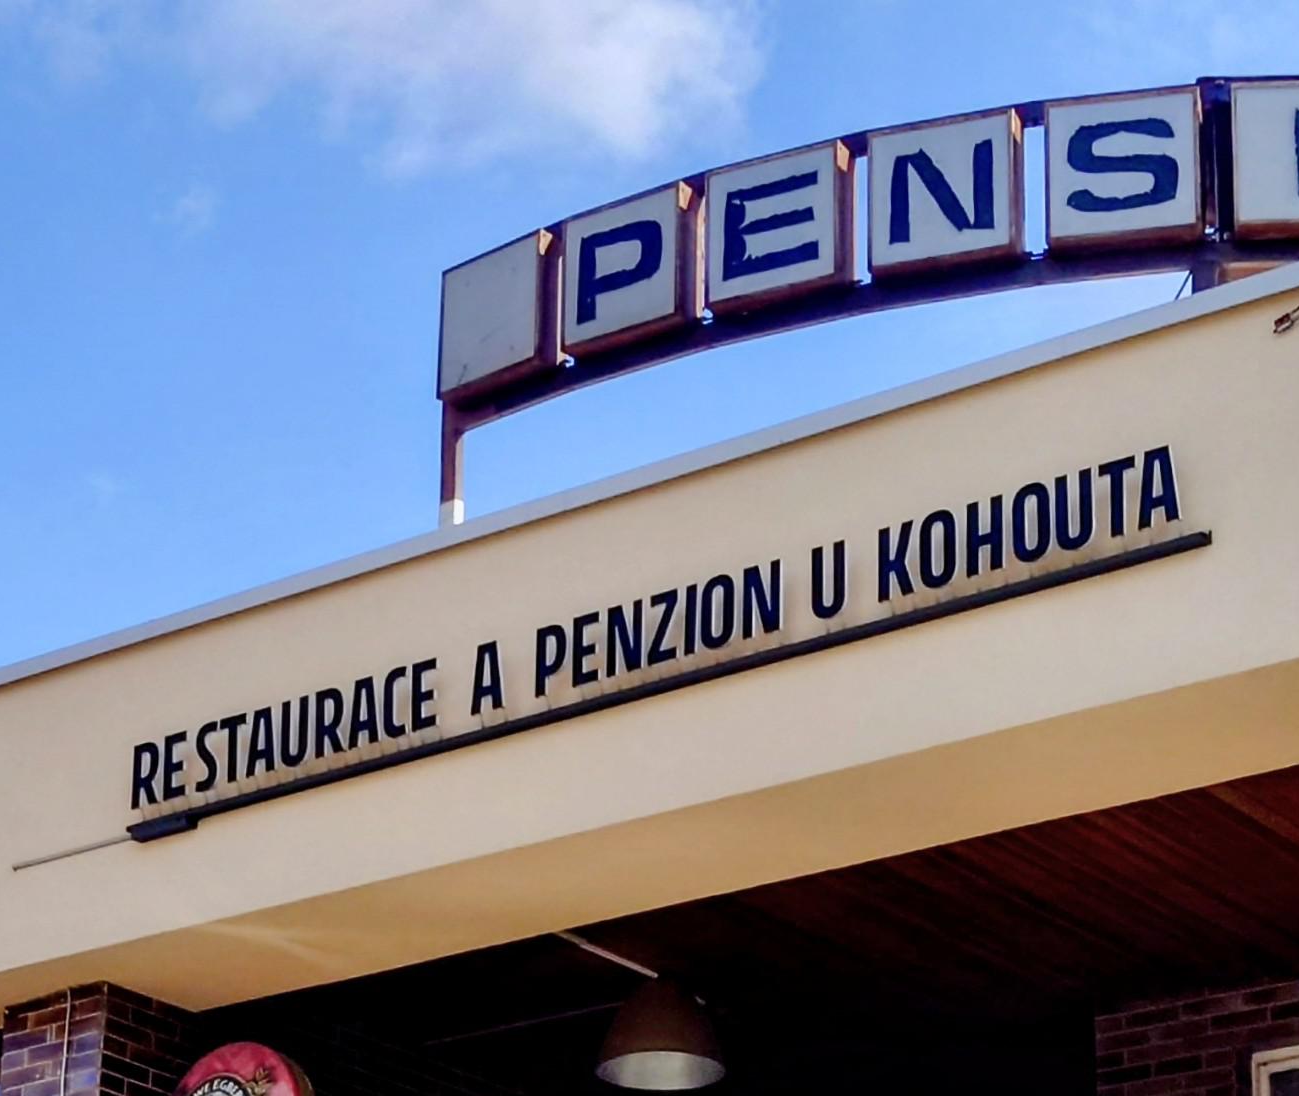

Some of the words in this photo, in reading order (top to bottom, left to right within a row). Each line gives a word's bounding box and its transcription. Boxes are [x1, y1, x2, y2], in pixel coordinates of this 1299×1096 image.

[131, 657, 438, 810] RESTAURACE
[470, 640, 504, 716] A
[534, 558, 781, 699] PENZION
[811, 539, 846, 620] U
[877, 444, 1182, 603] KOHOUTA
